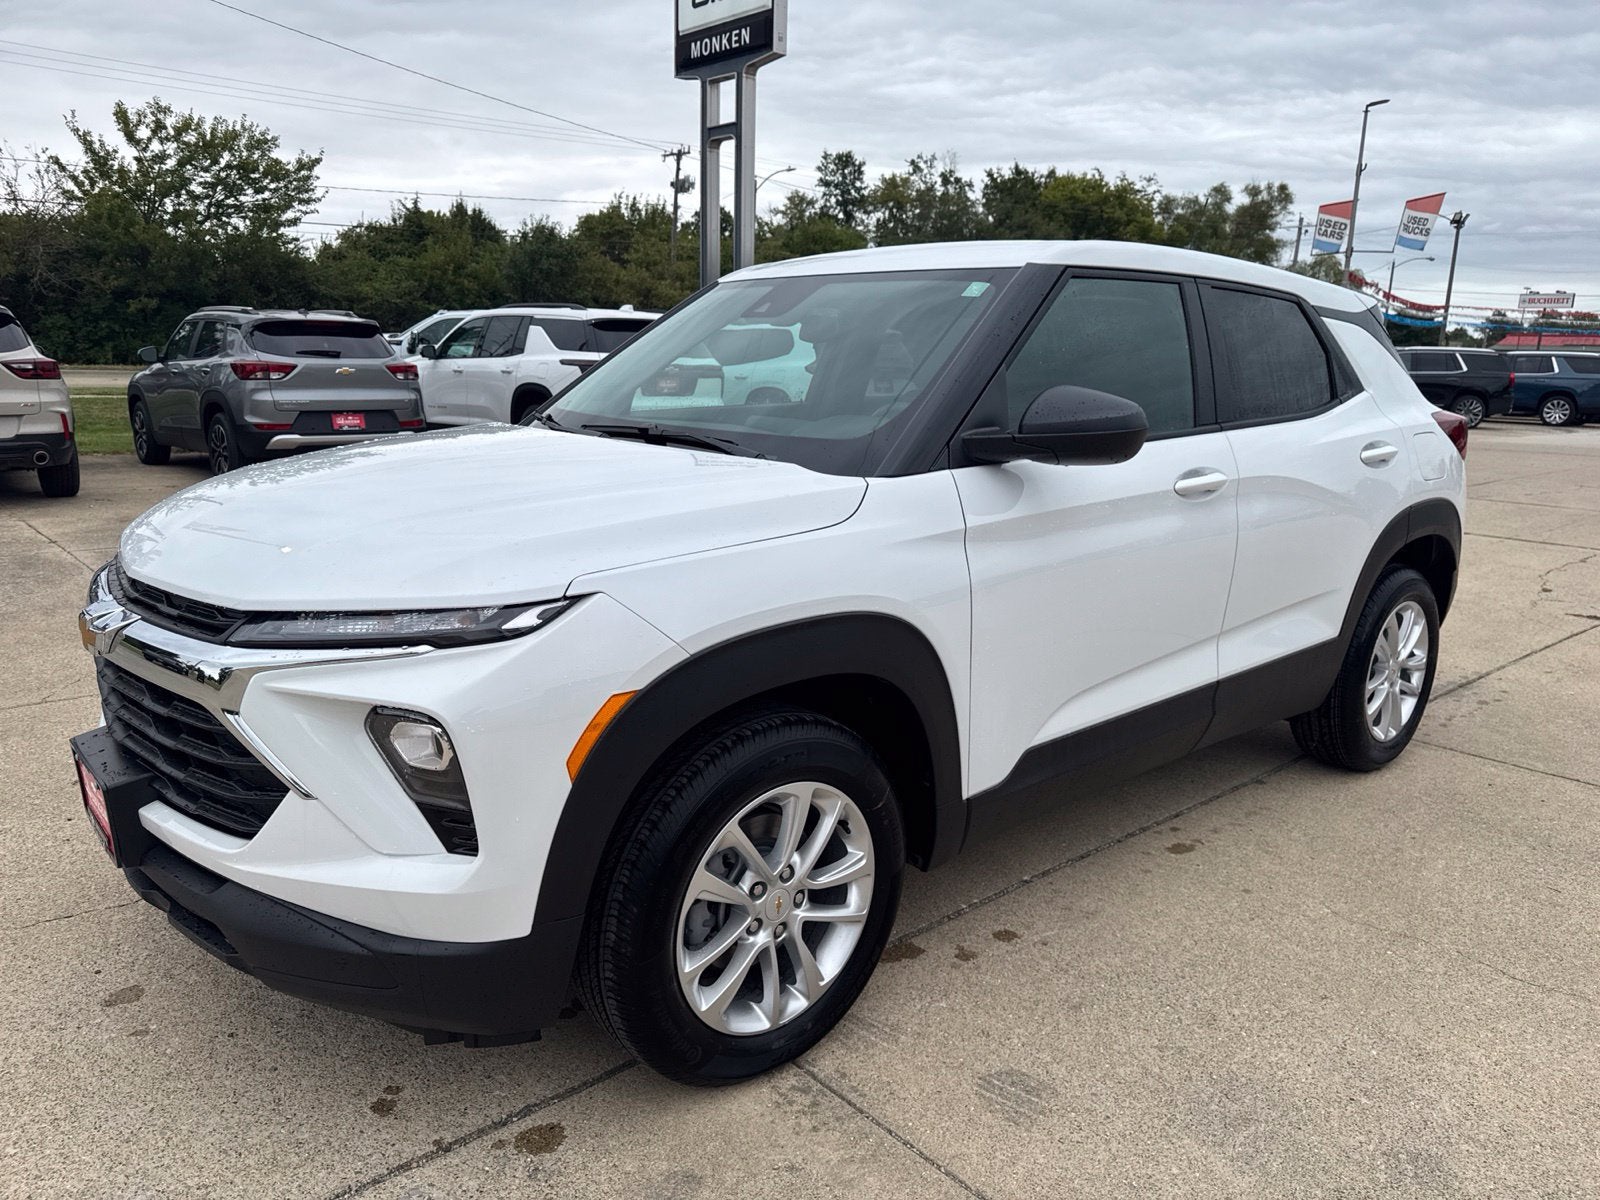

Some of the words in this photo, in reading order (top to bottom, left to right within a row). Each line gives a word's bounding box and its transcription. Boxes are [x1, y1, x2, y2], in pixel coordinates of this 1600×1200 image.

[690, 26, 750, 59] MONKEN
[1318, 217, 1348, 231] USED
[1406, 214, 1429, 226] USED
[1317, 227, 1345, 241] CARS
[1402, 223, 1431, 237] TRUCKS
